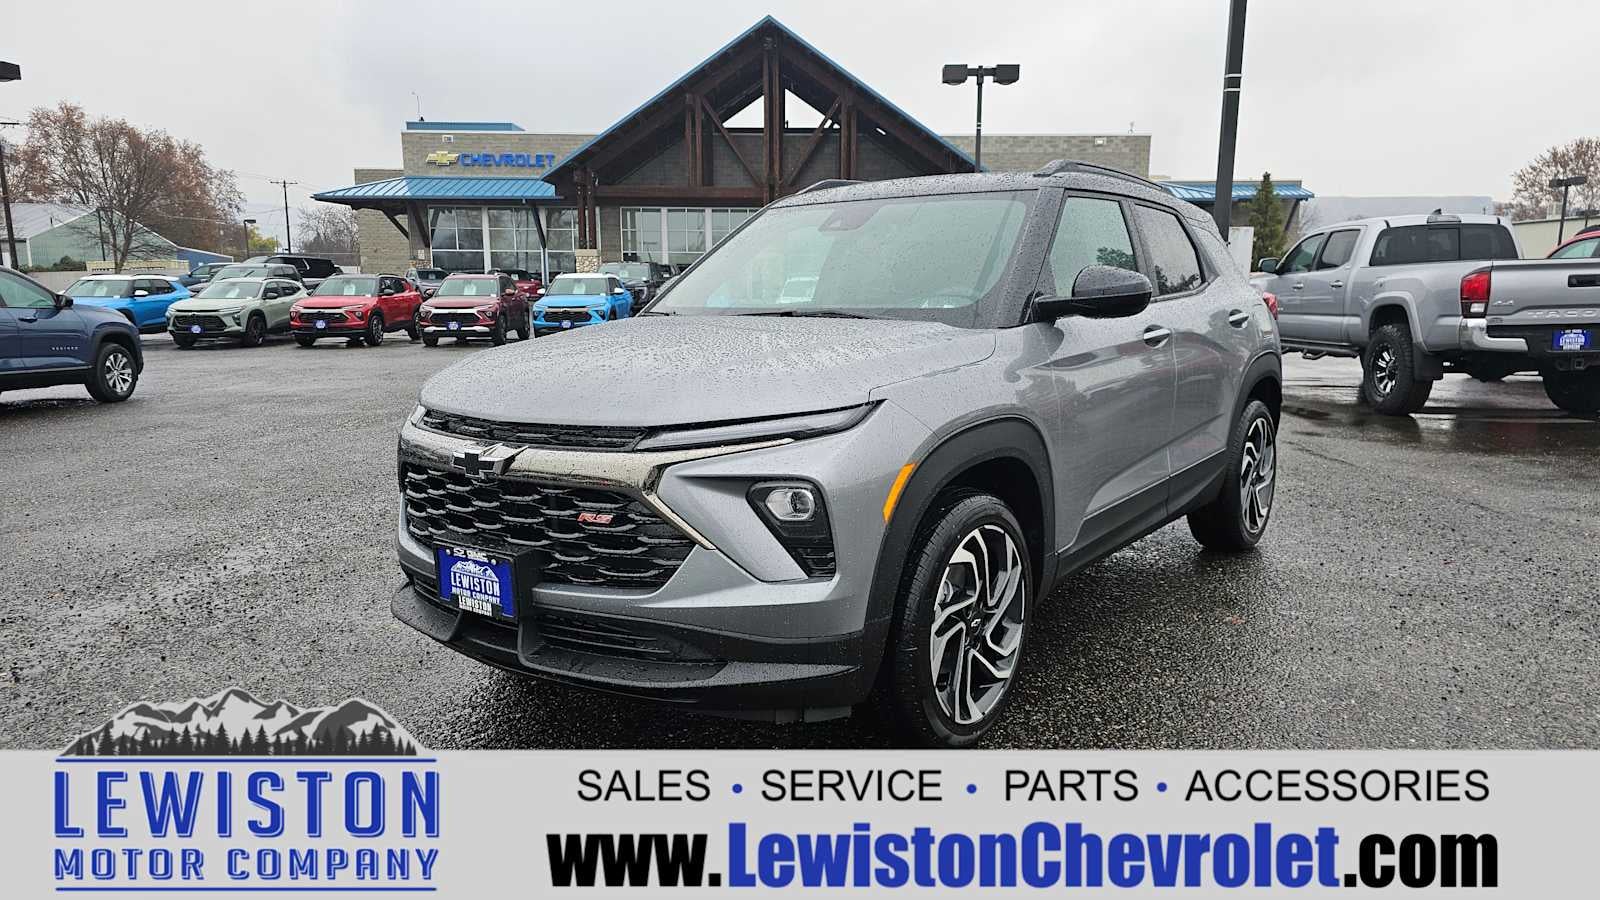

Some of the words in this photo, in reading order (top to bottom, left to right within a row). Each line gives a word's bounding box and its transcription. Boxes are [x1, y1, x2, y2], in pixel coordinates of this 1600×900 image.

[460, 153, 555, 168] CHEVROLET
[577, 512, 614, 524] RS
[451, 571, 501, 597] LEWISTON
[458, 595, 493, 612] LEWISTON
[472, 592, 501, 606] COMPANY
